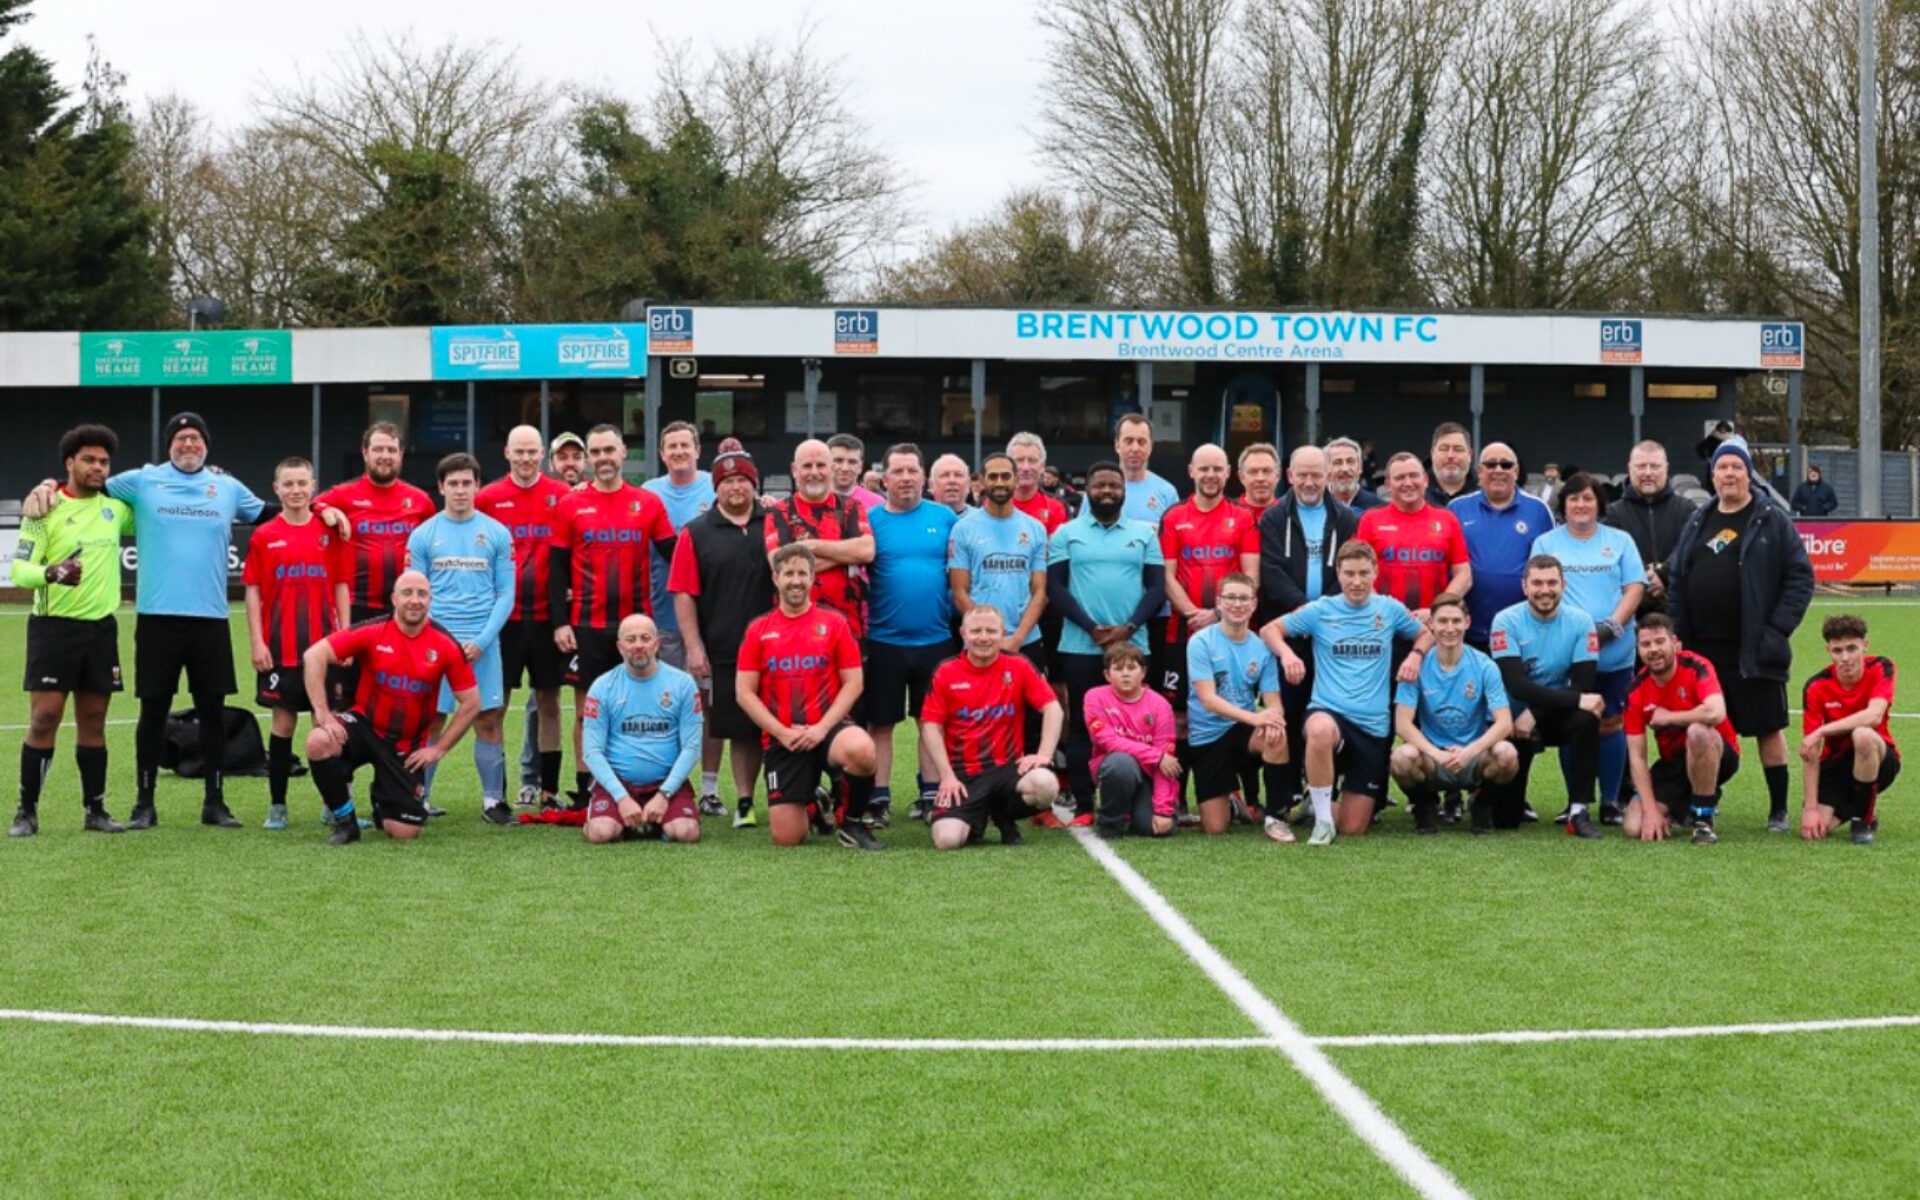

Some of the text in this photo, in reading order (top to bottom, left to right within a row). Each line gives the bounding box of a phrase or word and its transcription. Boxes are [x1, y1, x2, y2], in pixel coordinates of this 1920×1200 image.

[651, 309, 684, 331] erb
[836, 311, 868, 333] erb
[1017, 312, 1438, 343] BRENTWOOD TOWN FC
[1602, 320, 1633, 342] erb
[1763, 324, 1794, 346] erb
[453, 344, 517, 361] SPITFIRE
[561, 343, 625, 360] SPITFIRE
[1118, 342, 1344, 358] Brentwood Centre Arena
[95, 363, 140, 374] NEAME
[163, 363, 209, 373] NEAME
[231, 362, 276, 372] NEAME
[1382, 544, 1445, 562] dalau
[269, 672, 280, 690] 9
[1164, 670, 1180, 690] 12
[768, 770, 778, 790] 11
